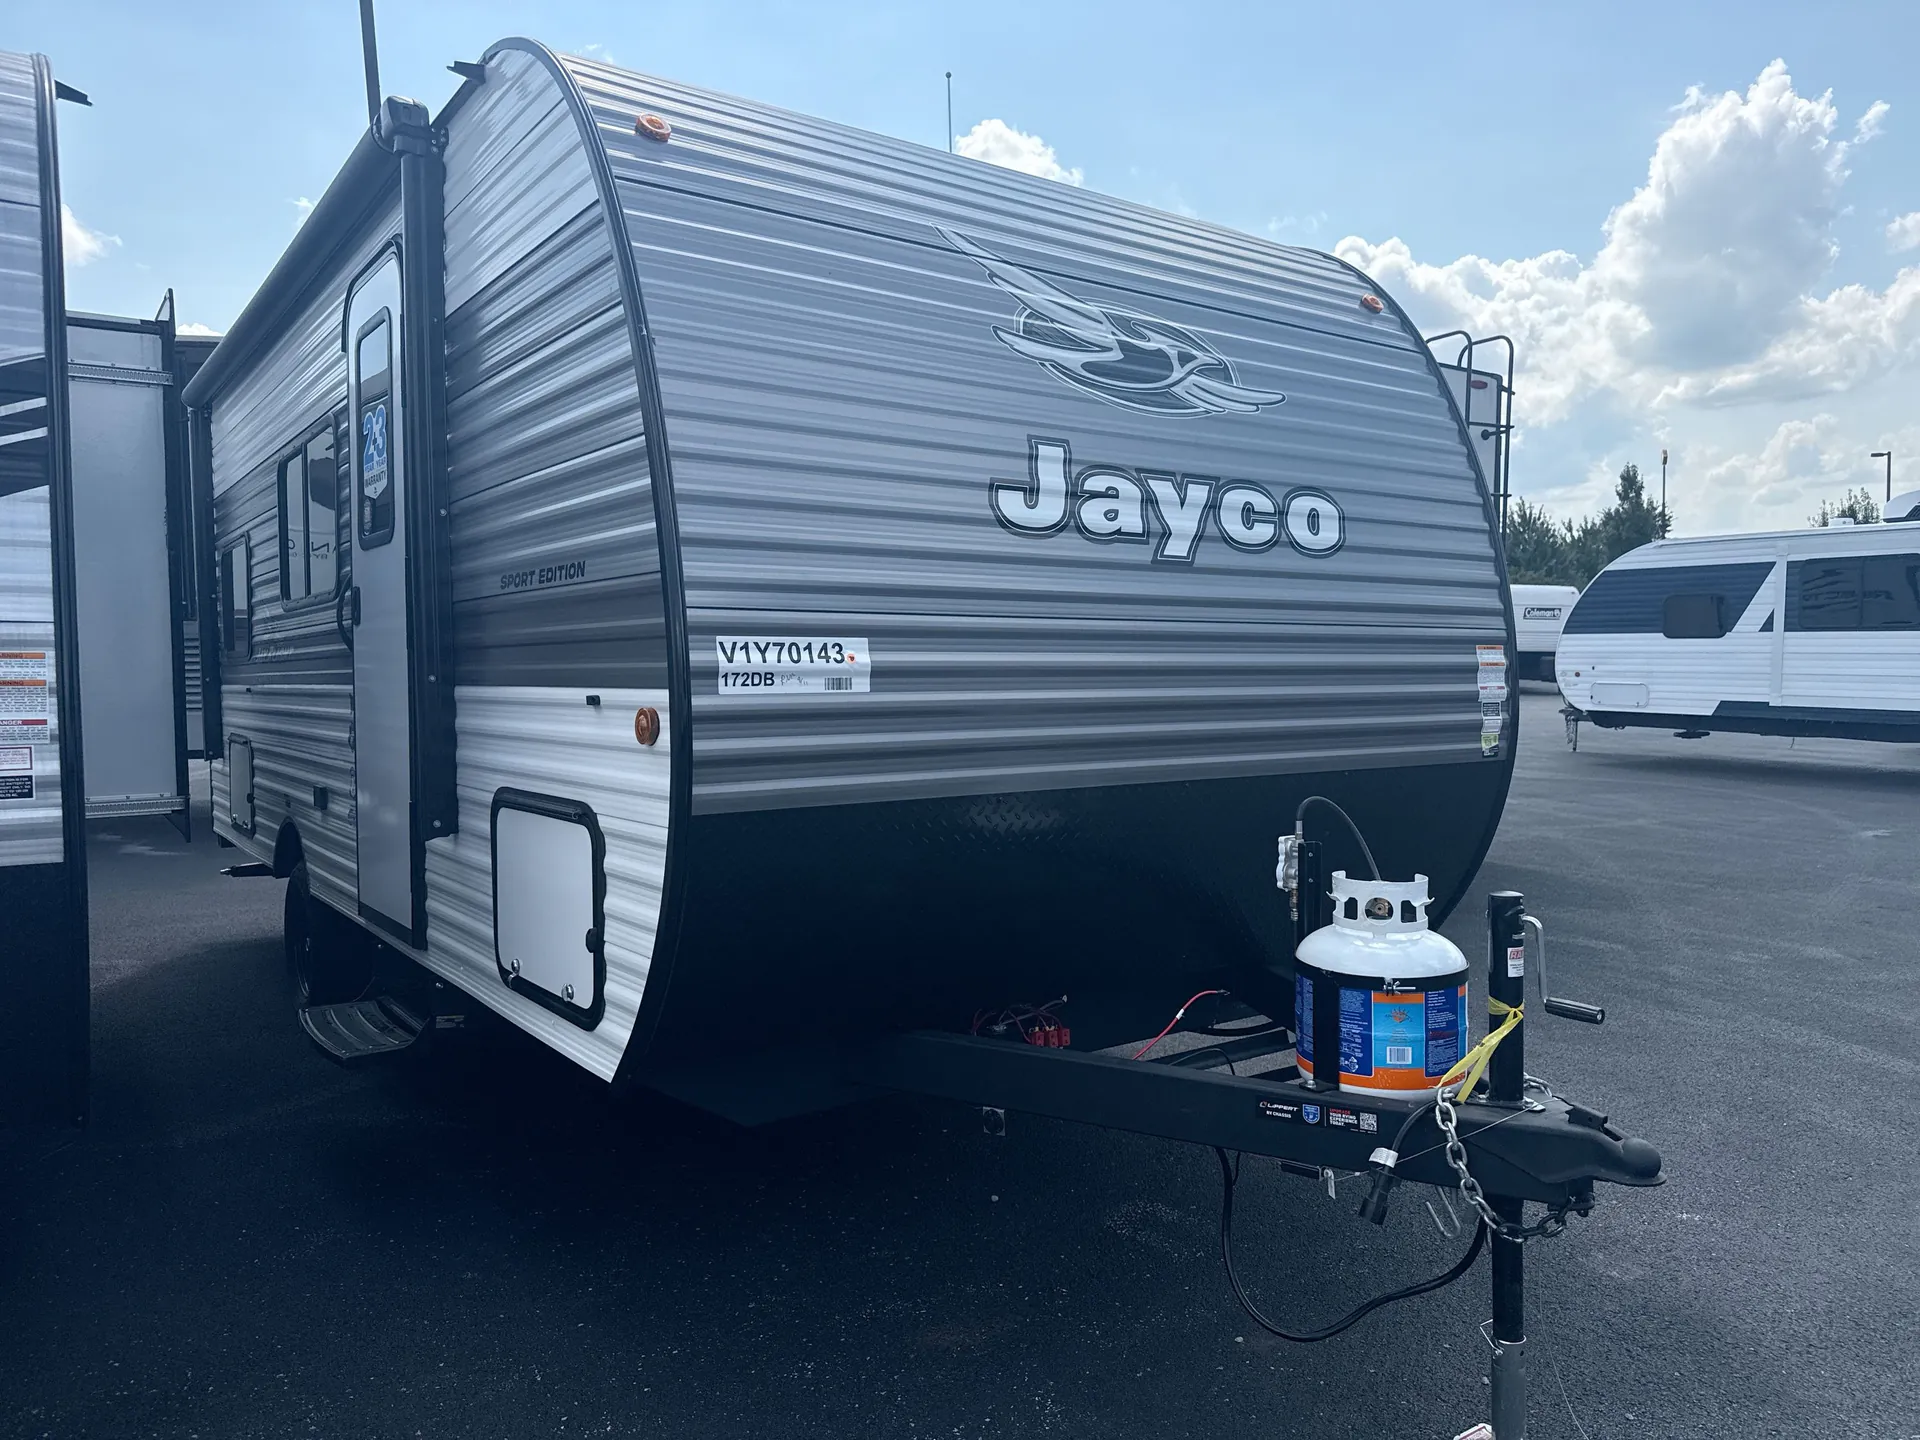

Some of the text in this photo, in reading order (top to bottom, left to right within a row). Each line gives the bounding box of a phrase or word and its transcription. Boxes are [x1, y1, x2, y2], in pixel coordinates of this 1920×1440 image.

[365, 469, 386, 489] WARRANTY
[988, 434, 1346, 566] Jayco
[500, 560, 586, 590] SPORT EDITION
[1525, 607, 1554, 618] Coleman
[718, 641, 845, 664] V1Y70143
[721, 672, 775, 687] 172DB
[1510, 950, 1524, 960] RA
[1272, 1111, 1292, 1119] CHASSIS
[1329, 1116, 1358, 1124] EXPERIENCE
